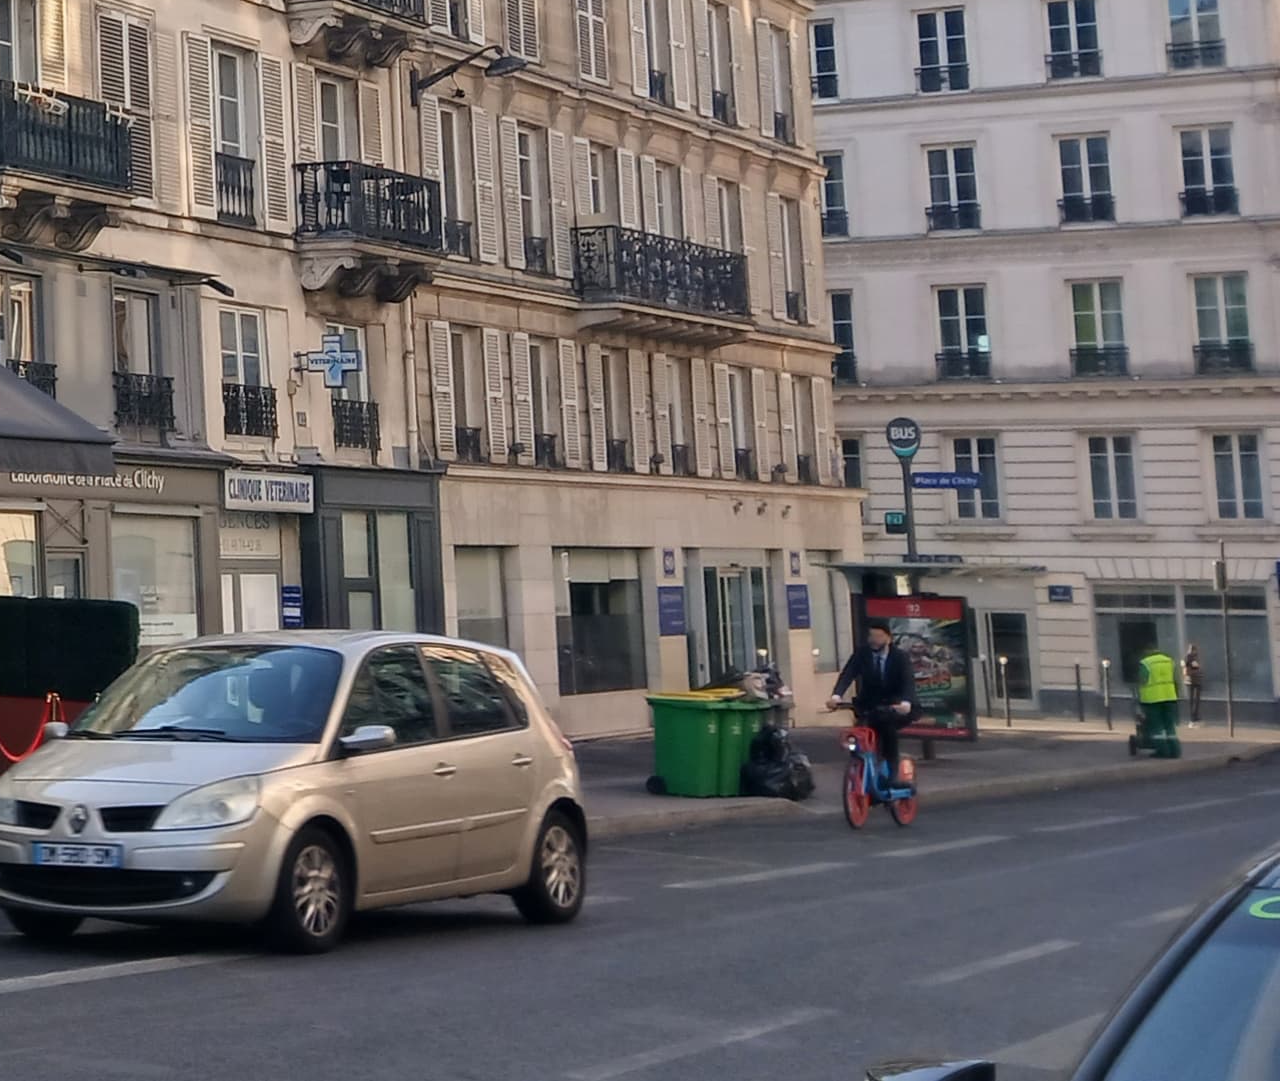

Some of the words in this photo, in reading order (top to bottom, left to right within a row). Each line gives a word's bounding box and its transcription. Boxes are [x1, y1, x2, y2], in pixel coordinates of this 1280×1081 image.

[890, 426, 916, 439] BUS
[123, 476, 133, 487] de
[134, 469, 165, 493] Clichy
[228, 478, 262, 503] CLINIQUE
[264, 480, 310, 503] VETERINAIRE
